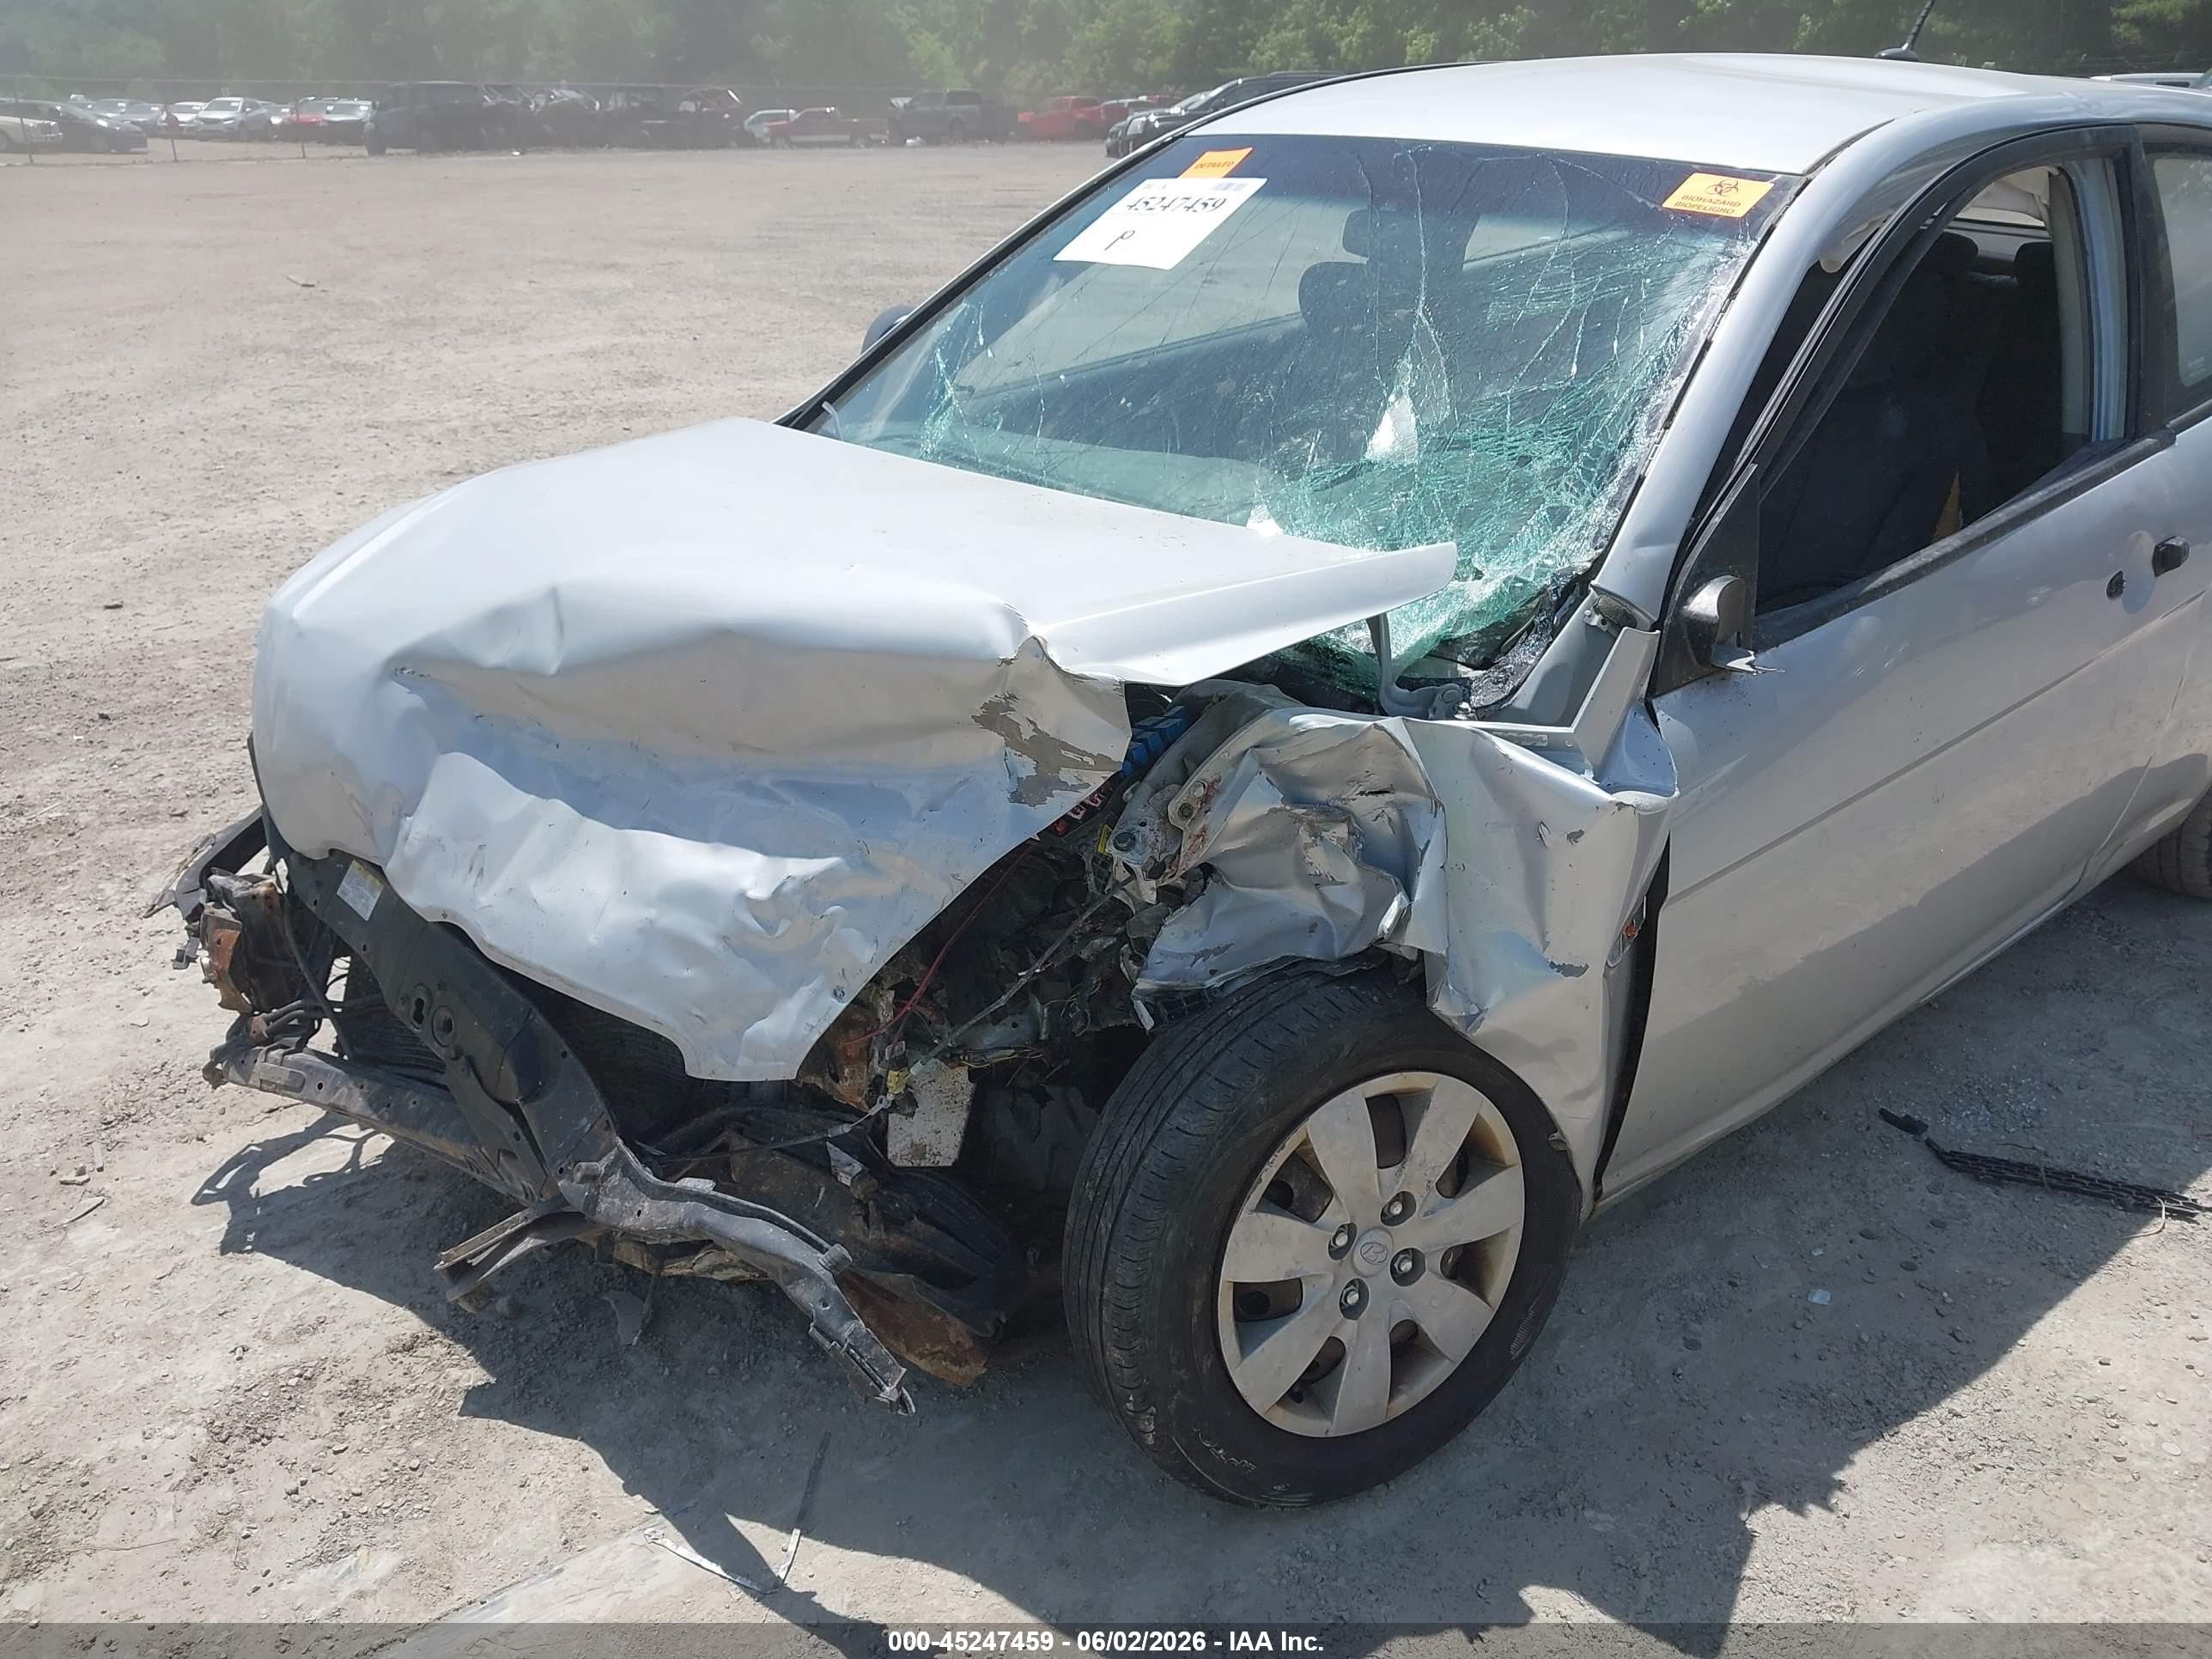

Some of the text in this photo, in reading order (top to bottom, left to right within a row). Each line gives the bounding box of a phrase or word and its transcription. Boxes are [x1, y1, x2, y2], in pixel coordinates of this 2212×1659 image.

[1127, 196, 1228, 213] 45247459
[1674, 201, 1735, 214] BIOPELIGRO
[1681, 195, 1741, 207] BIOHAZARD
